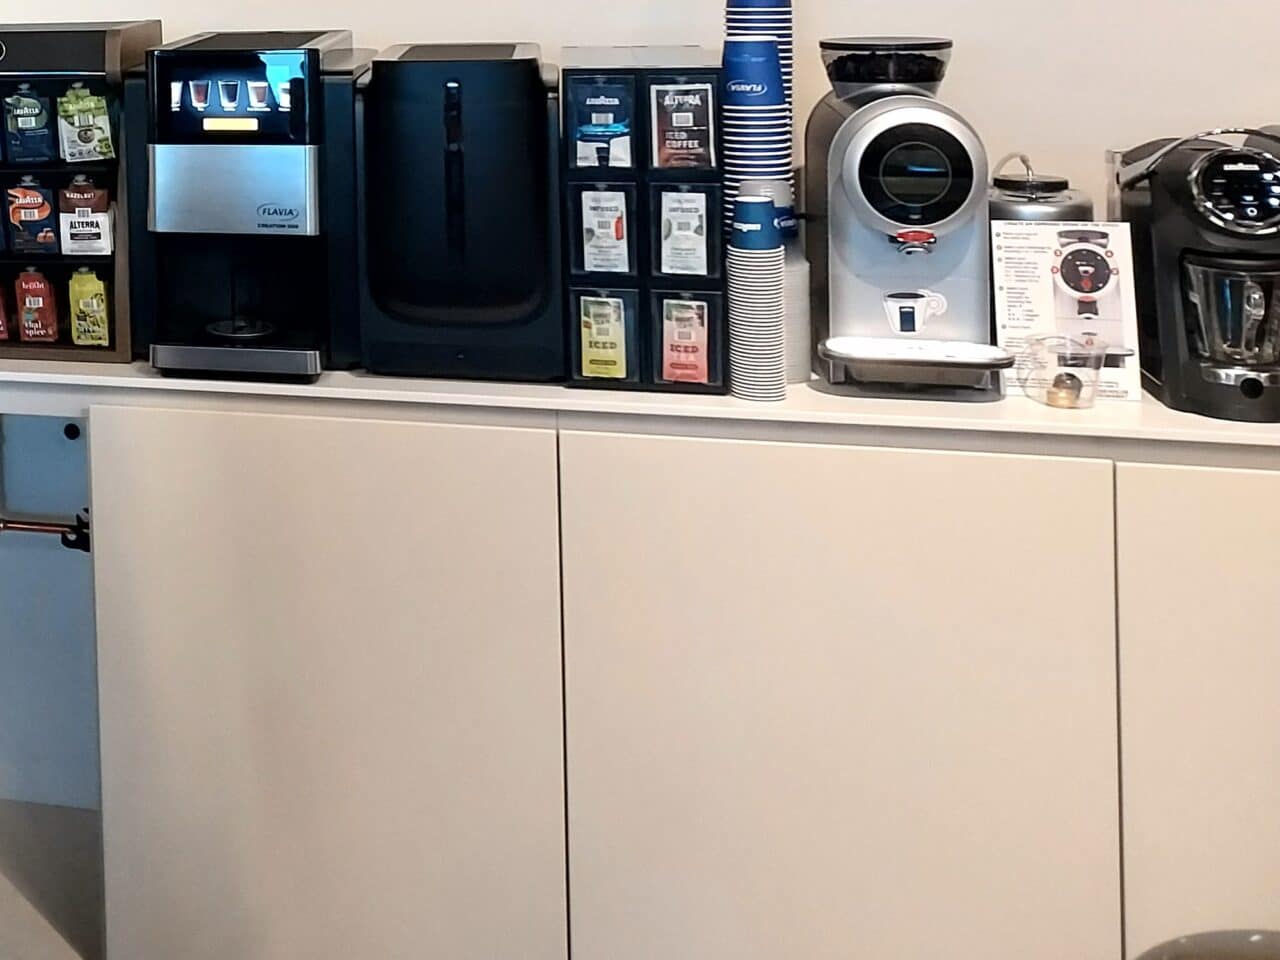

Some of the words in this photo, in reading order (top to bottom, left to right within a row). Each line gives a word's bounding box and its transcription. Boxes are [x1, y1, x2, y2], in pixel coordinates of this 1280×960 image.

[262, 207, 295, 217] FLAVIA
[69, 220, 100, 230] ALTERRA
[588, 340, 619, 350] ICED
[669, 343, 700, 353] ICED
